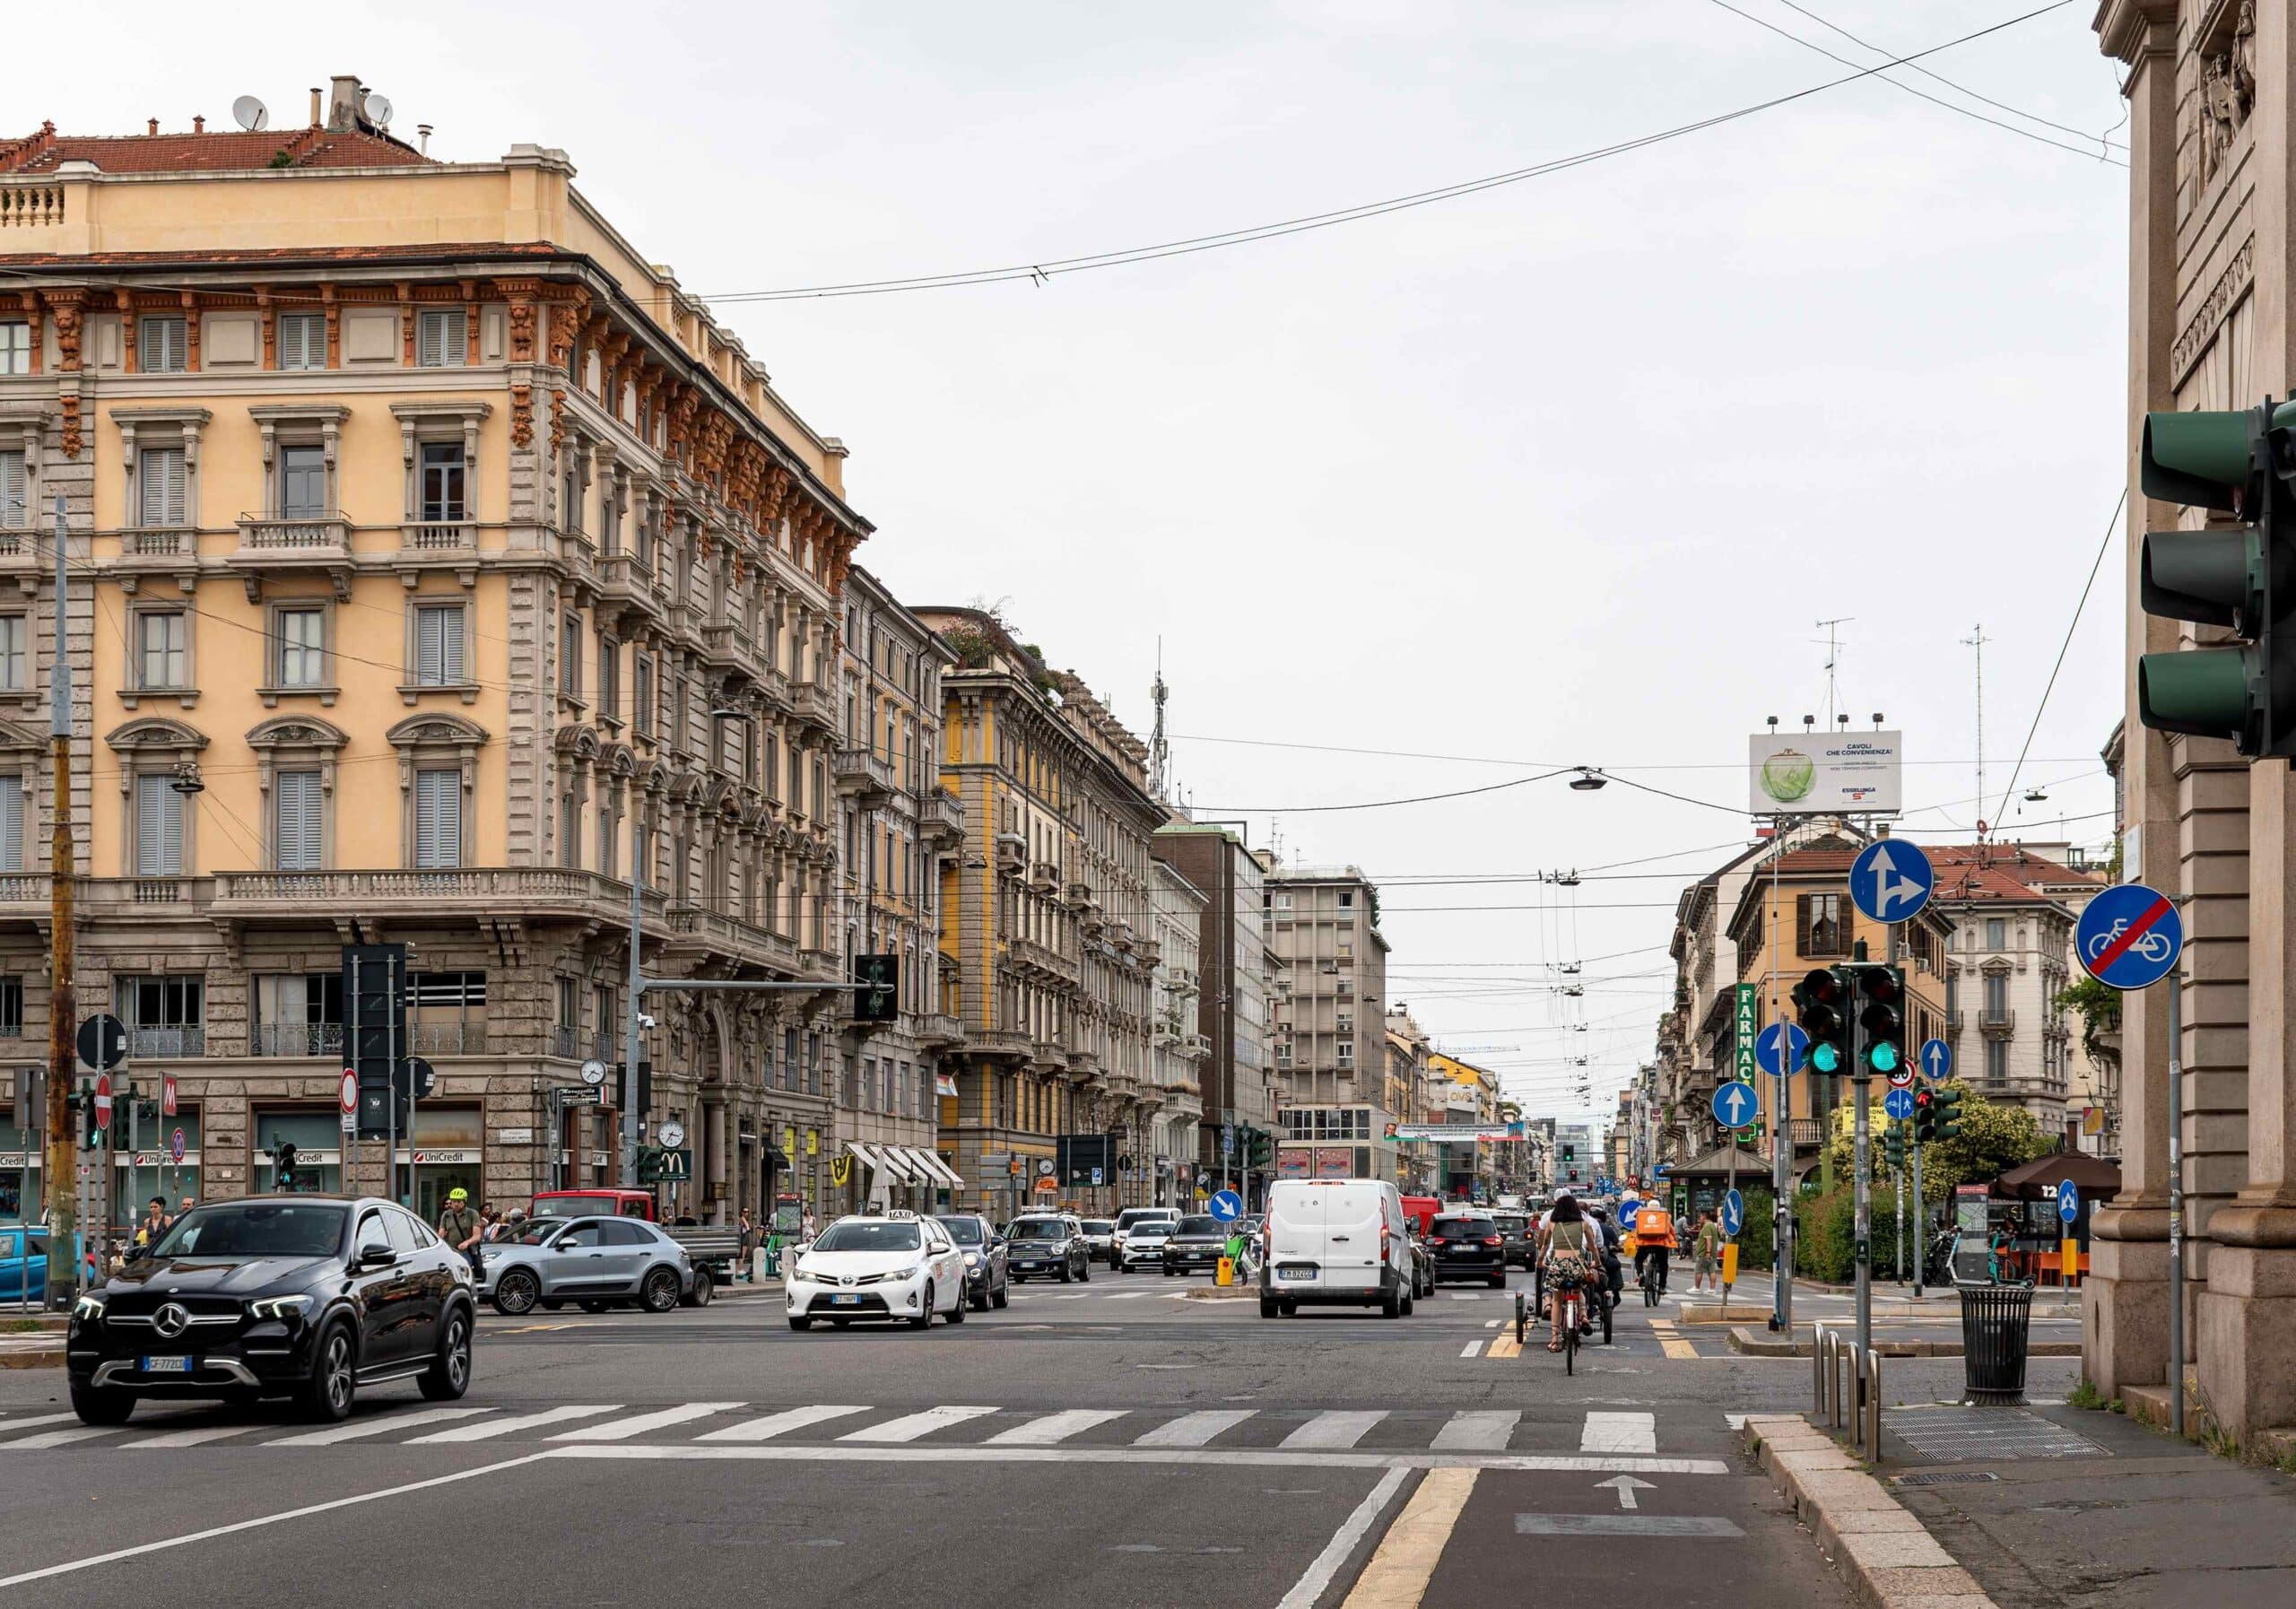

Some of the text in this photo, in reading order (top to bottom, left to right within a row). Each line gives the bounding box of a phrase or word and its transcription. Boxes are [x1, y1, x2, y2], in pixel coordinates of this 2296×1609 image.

[1841, 748, 1893, 756] CONVENIENZA!
[1739, 989, 1752, 1080] FARMAC
[165, 1083, 176, 1106] M
[1449, 1092, 1472, 1101] OVS
[0, 1156, 25, 1165] Credit
[295, 1152, 322, 1162] iCredit
[424, 1152, 463, 1162] UniCredit
[2041, 1185, 2058, 1198] 12
[889, 1211, 911, 1219] TAXI
